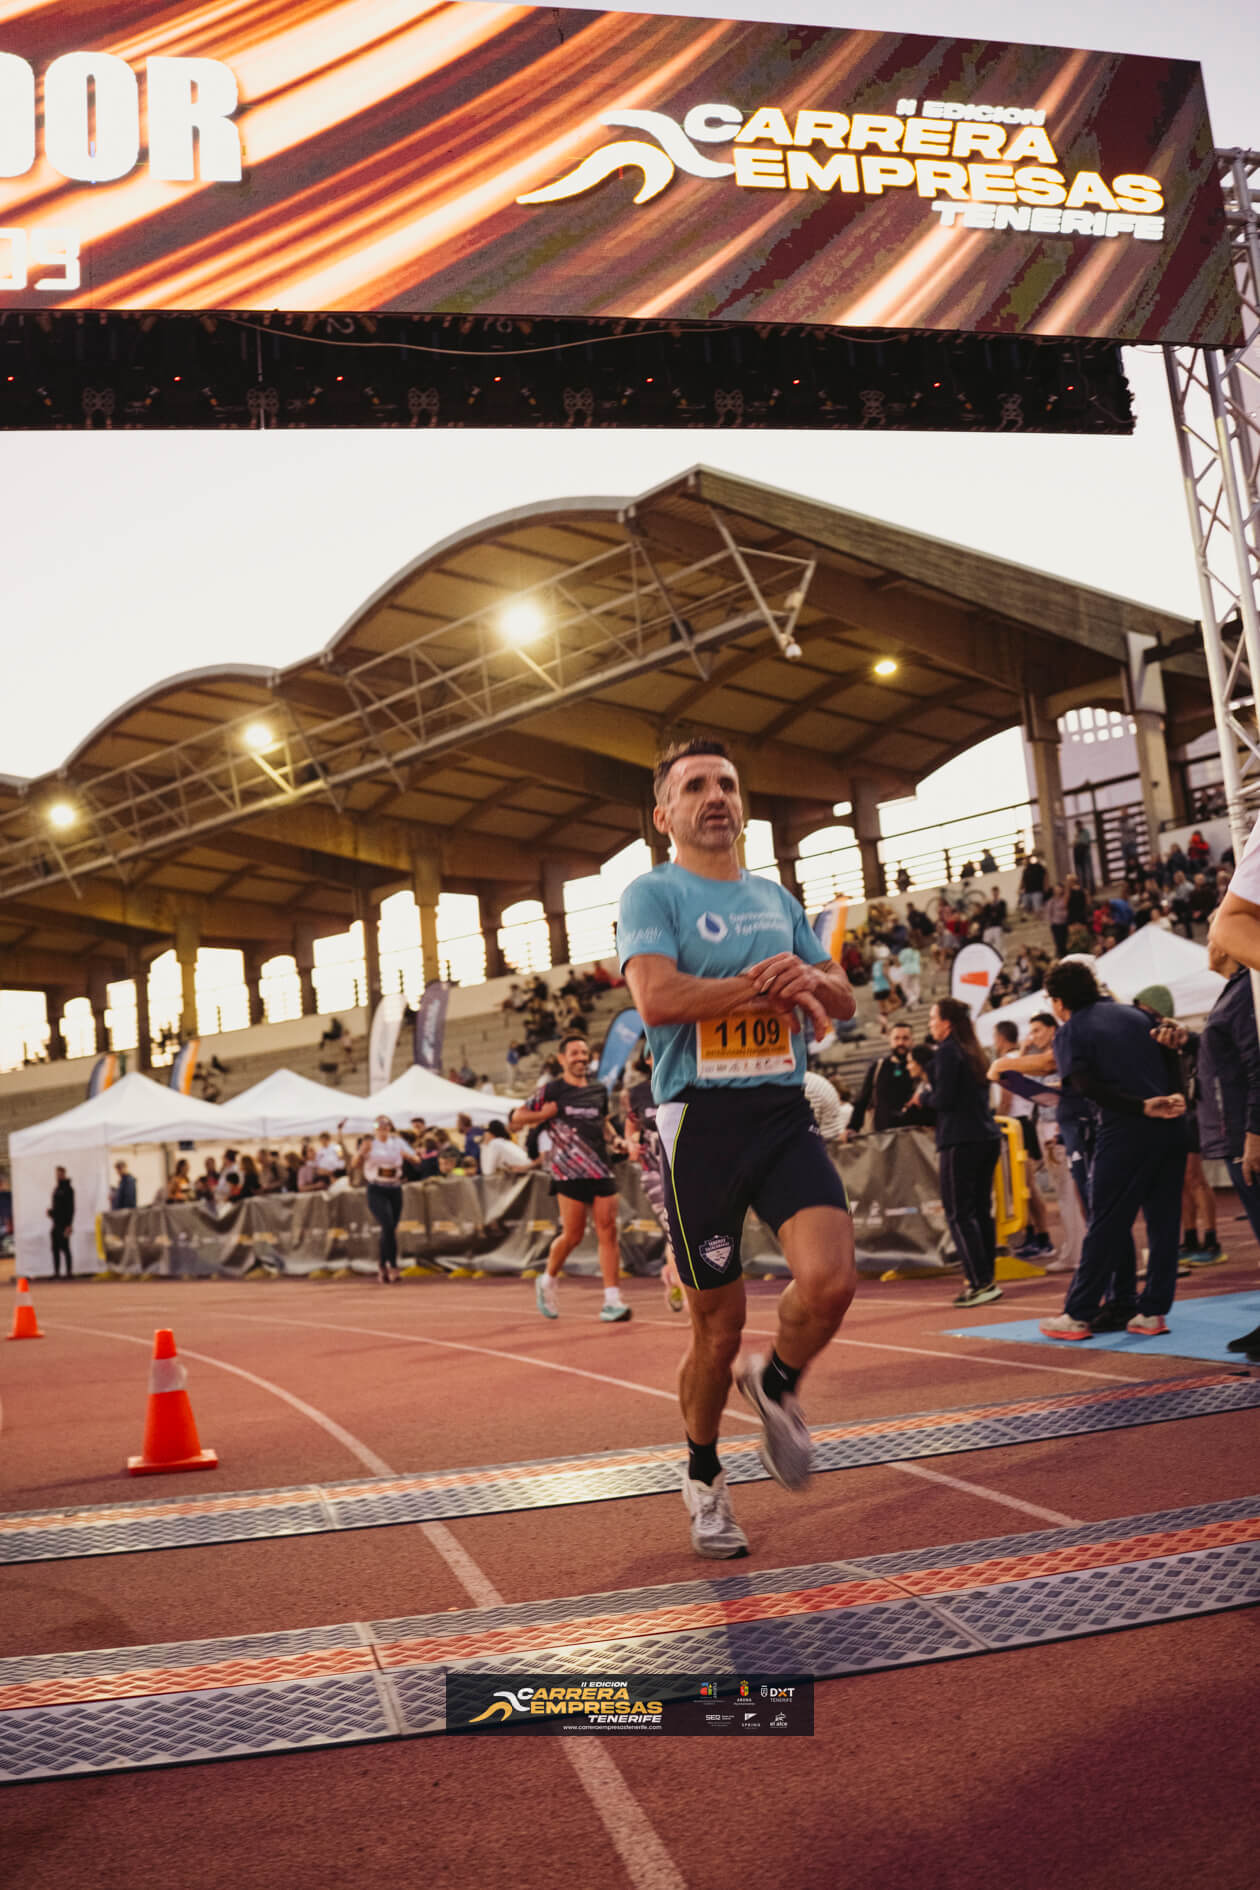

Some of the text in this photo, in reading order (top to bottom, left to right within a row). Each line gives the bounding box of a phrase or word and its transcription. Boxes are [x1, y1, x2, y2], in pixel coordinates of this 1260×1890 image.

[684, 103, 1058, 164] CARRERA
[922, 100, 1046, 126] EDICION
[733, 147, 1165, 213] EMPRESAS
[931, 200, 1165, 241] TENERIFE
[714, 1018, 780, 1048] 1109
